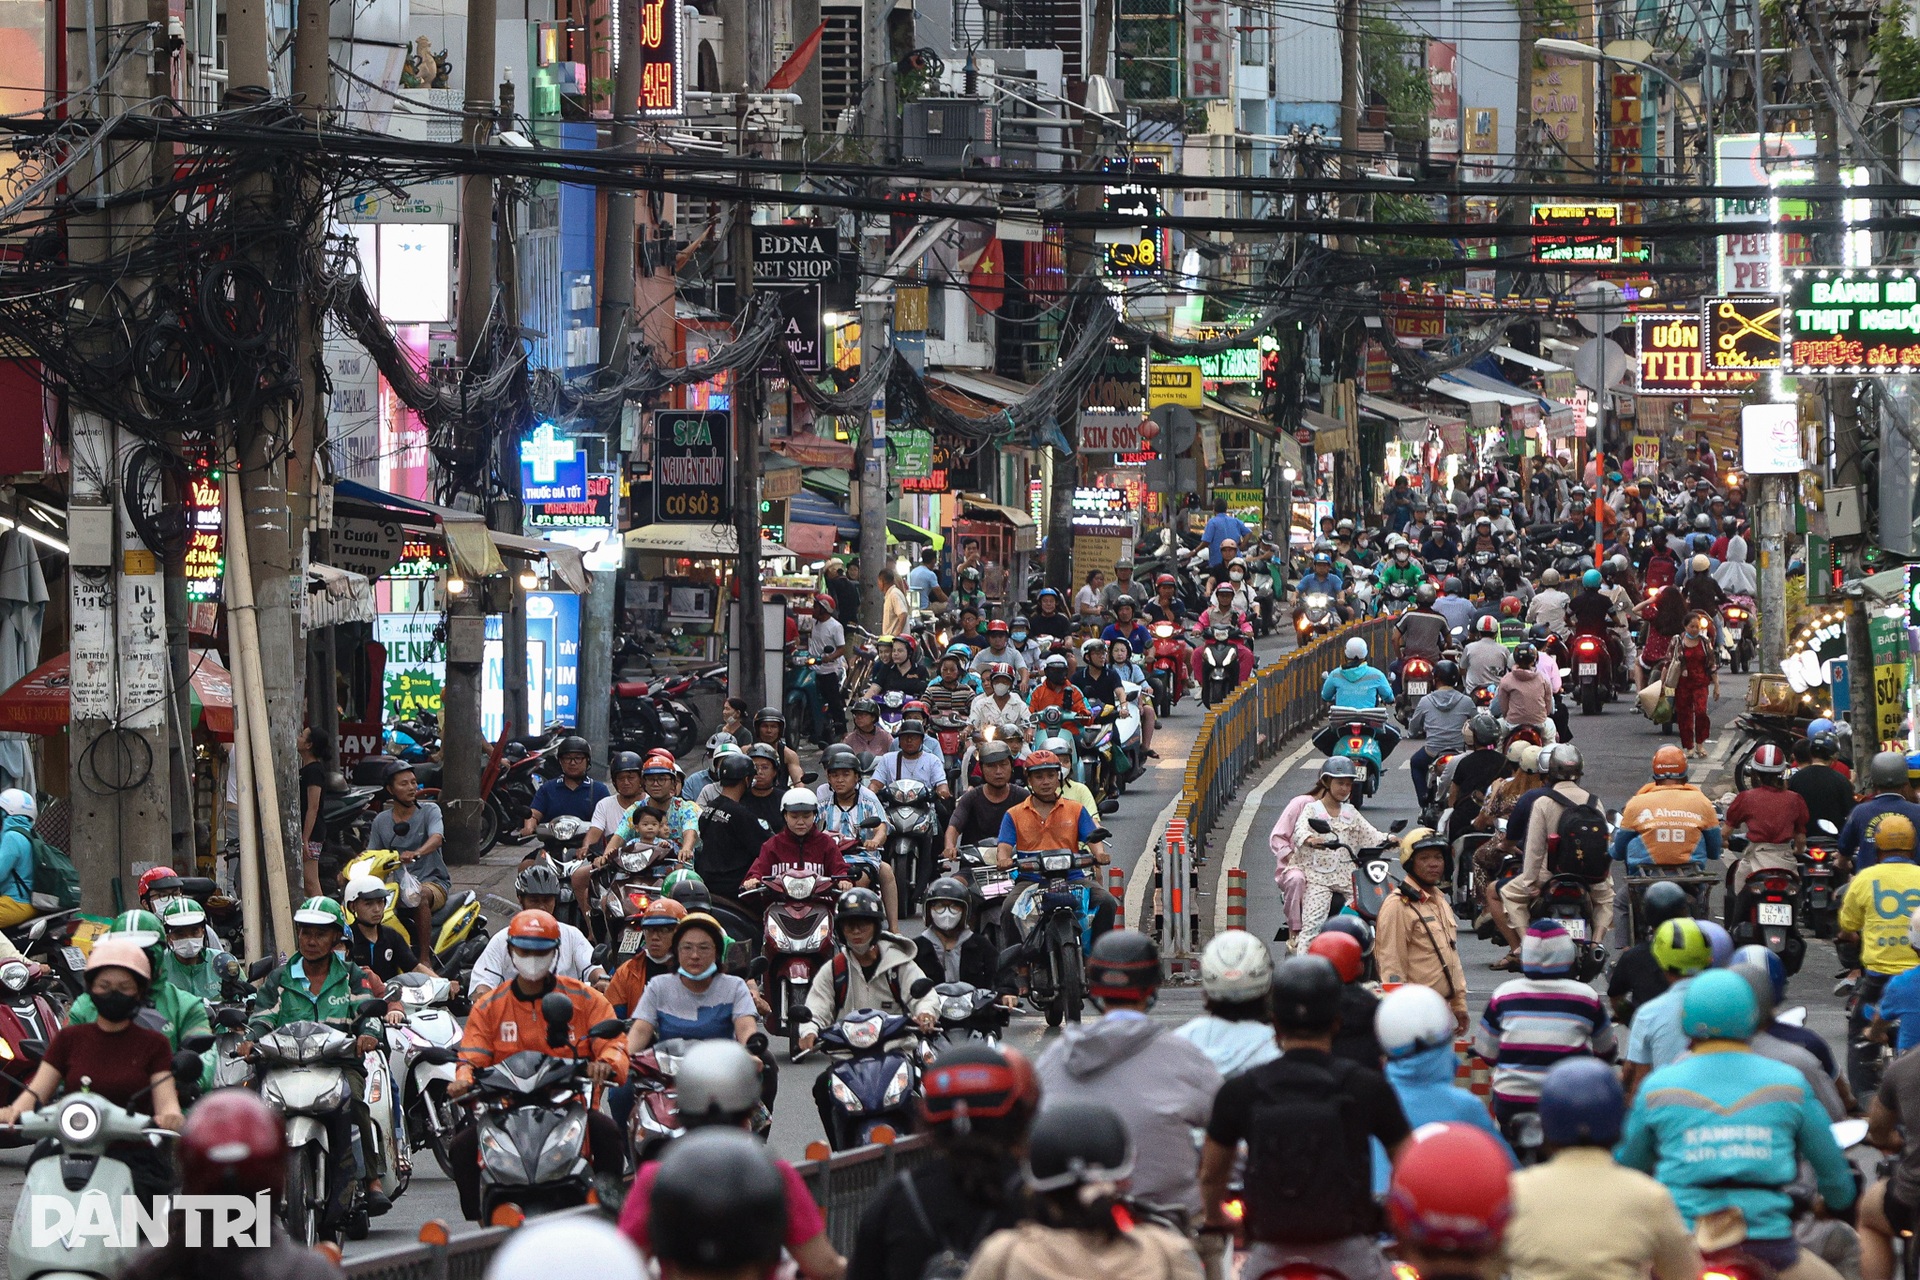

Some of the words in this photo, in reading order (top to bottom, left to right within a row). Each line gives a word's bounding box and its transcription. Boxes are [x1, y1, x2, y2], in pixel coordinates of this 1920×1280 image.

[1532, 87, 1578, 113] CẦM
[760, 236, 824, 254] EDNA
[787, 260, 832, 277] SHOP
[1812, 277, 1880, 303] BÁNH
[1885, 277, 1917, 303] MÌ
[1652, 319, 1699, 348] UỐN
[1795, 309, 1854, 334] THỊT
[674, 420, 712, 445] SPA
[1083, 426, 1108, 449] KIM
[1112, 423, 1137, 449] SƠN
[661, 448, 698, 485] NGUYÊN
[699, 447, 725, 485] THỦY
[525, 485, 551, 500] THUỐC
[552, 485, 566, 499] GIÁ
[566, 484, 581, 498] TỐT
[666, 493, 687, 514] CƠ
[689, 490, 708, 514] SỞ
[711, 496, 720, 515] 3
[651, 538, 686, 546] COFFEE
[26, 689, 67, 697] COFFEE
[400, 676, 411, 690] 3
[411, 678, 431, 687] Tháng
[390, 691, 441, 713] TẶNG
[1873, 879, 1920, 919] be
